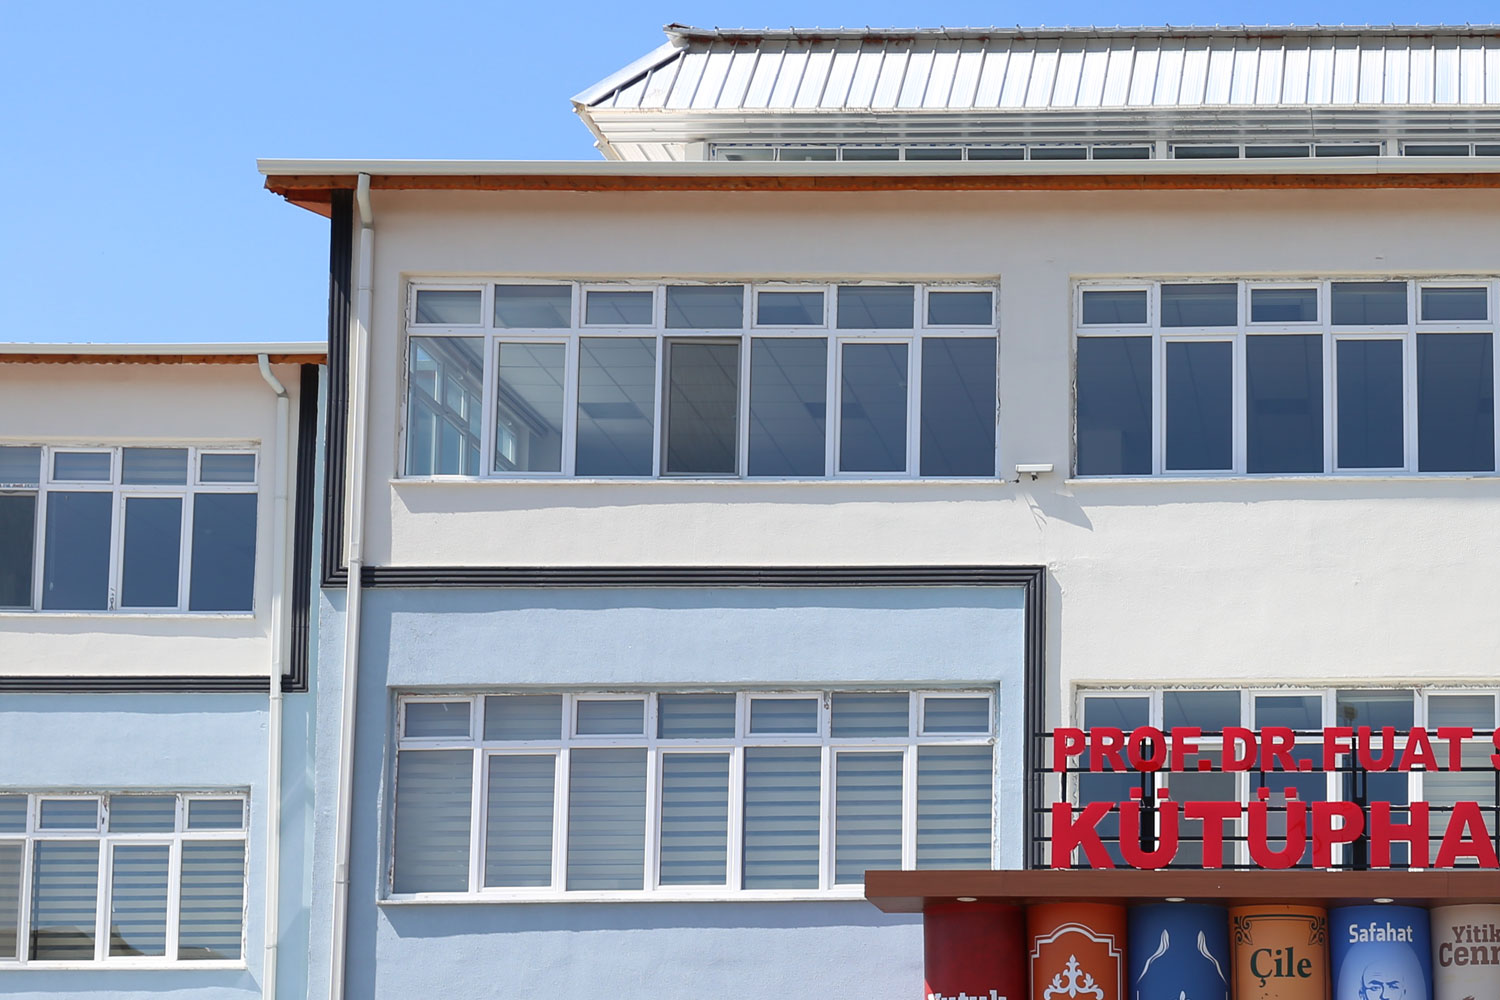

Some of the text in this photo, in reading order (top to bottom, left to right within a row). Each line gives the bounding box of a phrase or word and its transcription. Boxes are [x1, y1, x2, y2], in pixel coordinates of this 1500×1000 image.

[1053, 726, 1212, 773] PROF.
[1222, 726, 1312, 773] DR.
[1324, 726, 1473, 772] FUAT
[1348, 922, 1413, 943] Safahat
[1250, 946, 1312, 989] Çile
